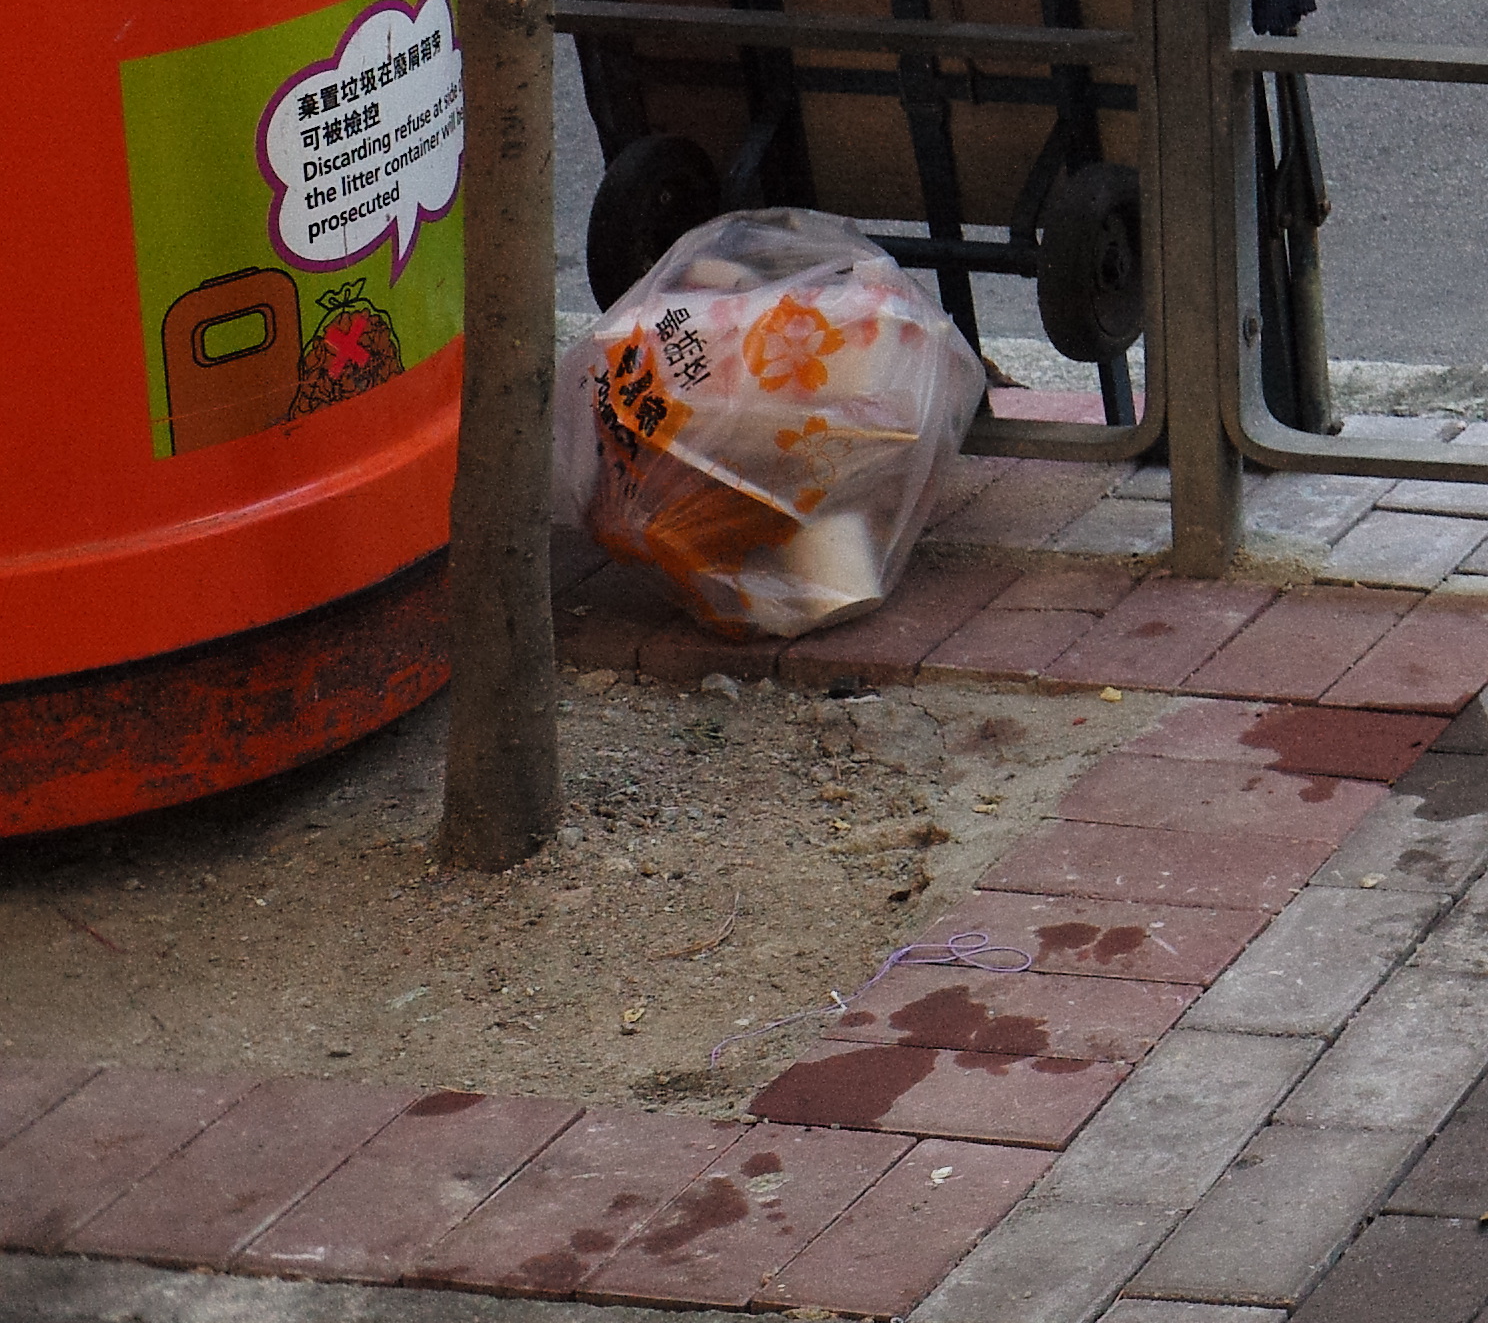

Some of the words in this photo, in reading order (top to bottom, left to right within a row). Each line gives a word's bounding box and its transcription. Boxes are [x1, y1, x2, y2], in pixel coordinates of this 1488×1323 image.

[297, 29, 441, 122] 棄置垃圾在廢屑箱旁
[300, 101, 381, 152] 可被檢控
[303, 133, 391, 182] Discarding
[394, 109, 431, 143] refuse
[433, 97, 442, 118] at
[444, 83, 458, 111] side
[304, 183, 337, 210] the
[341, 166, 381, 197] litter
[384, 132, 440, 177] container
[441, 111, 456, 141] will
[308, 180, 400, 244] prosecuted
